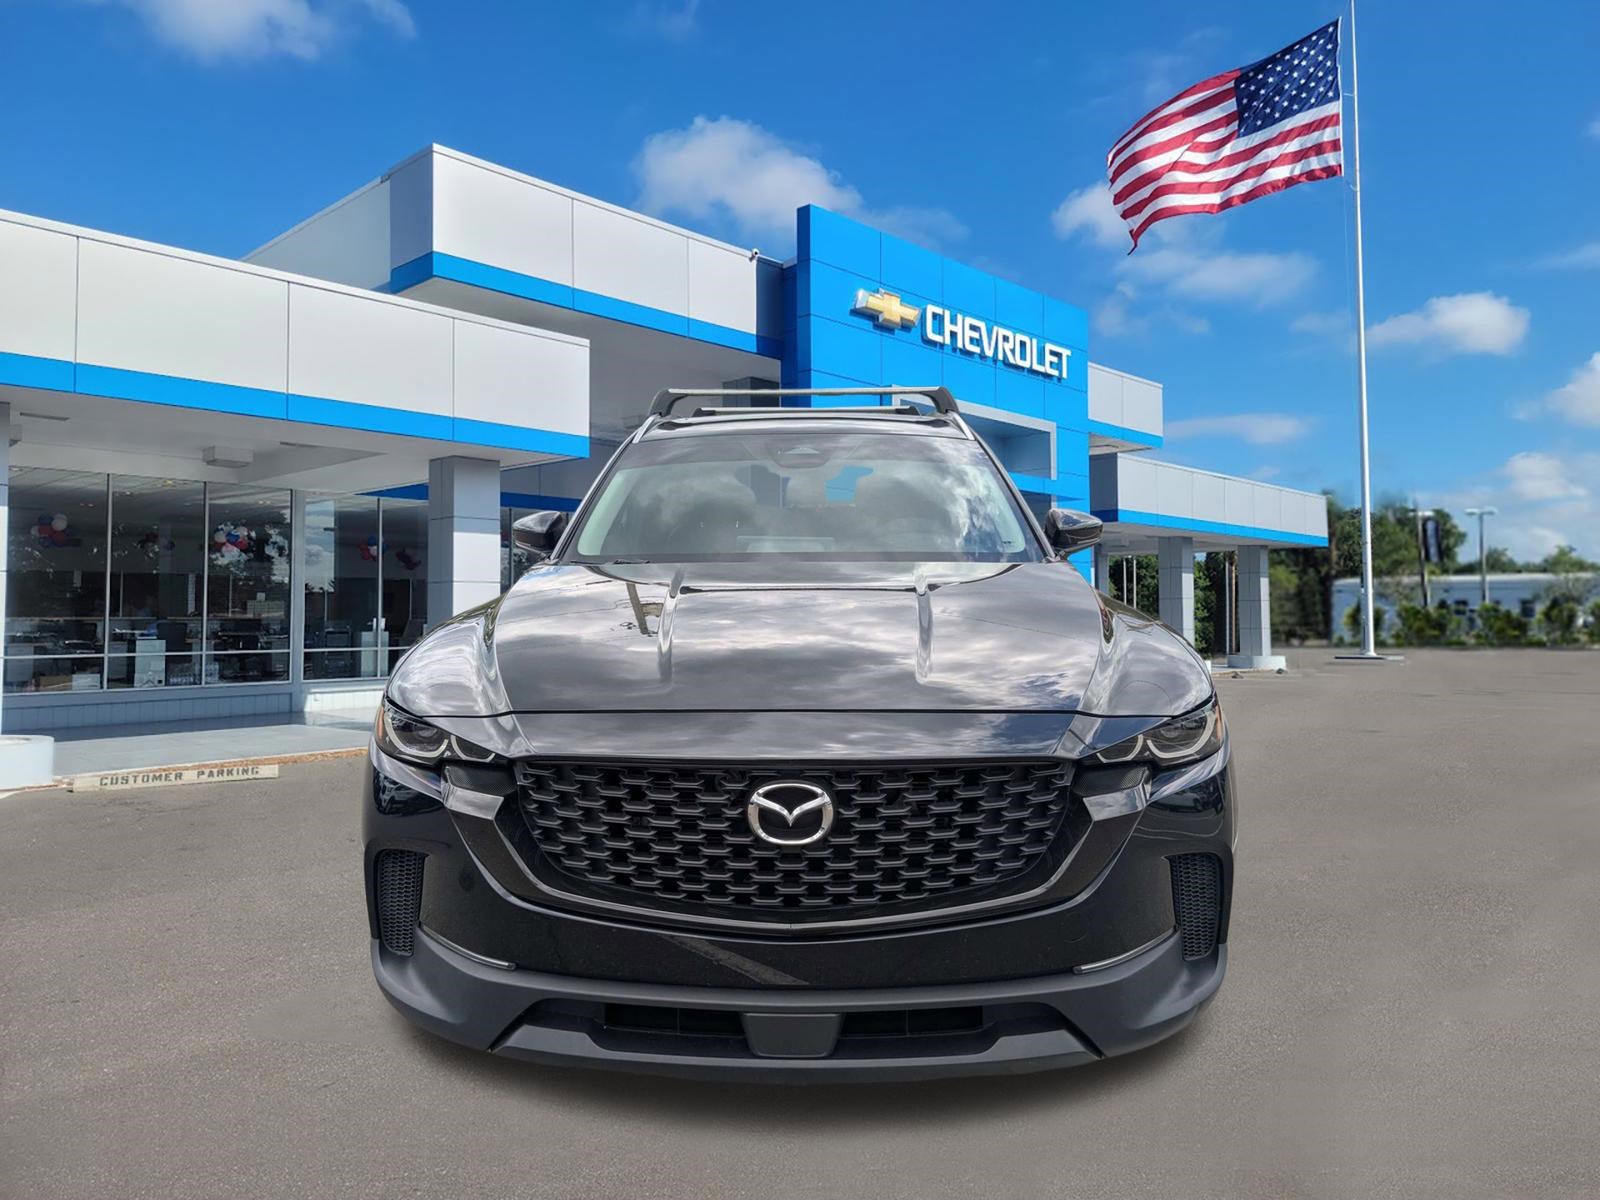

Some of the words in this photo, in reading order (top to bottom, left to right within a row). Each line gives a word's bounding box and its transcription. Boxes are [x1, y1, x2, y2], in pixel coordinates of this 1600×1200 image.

[926, 304, 1071, 378] CHEVROLET
[99, 772, 183, 786] CUSTOMER
[196, 766, 259, 779] PARKING
